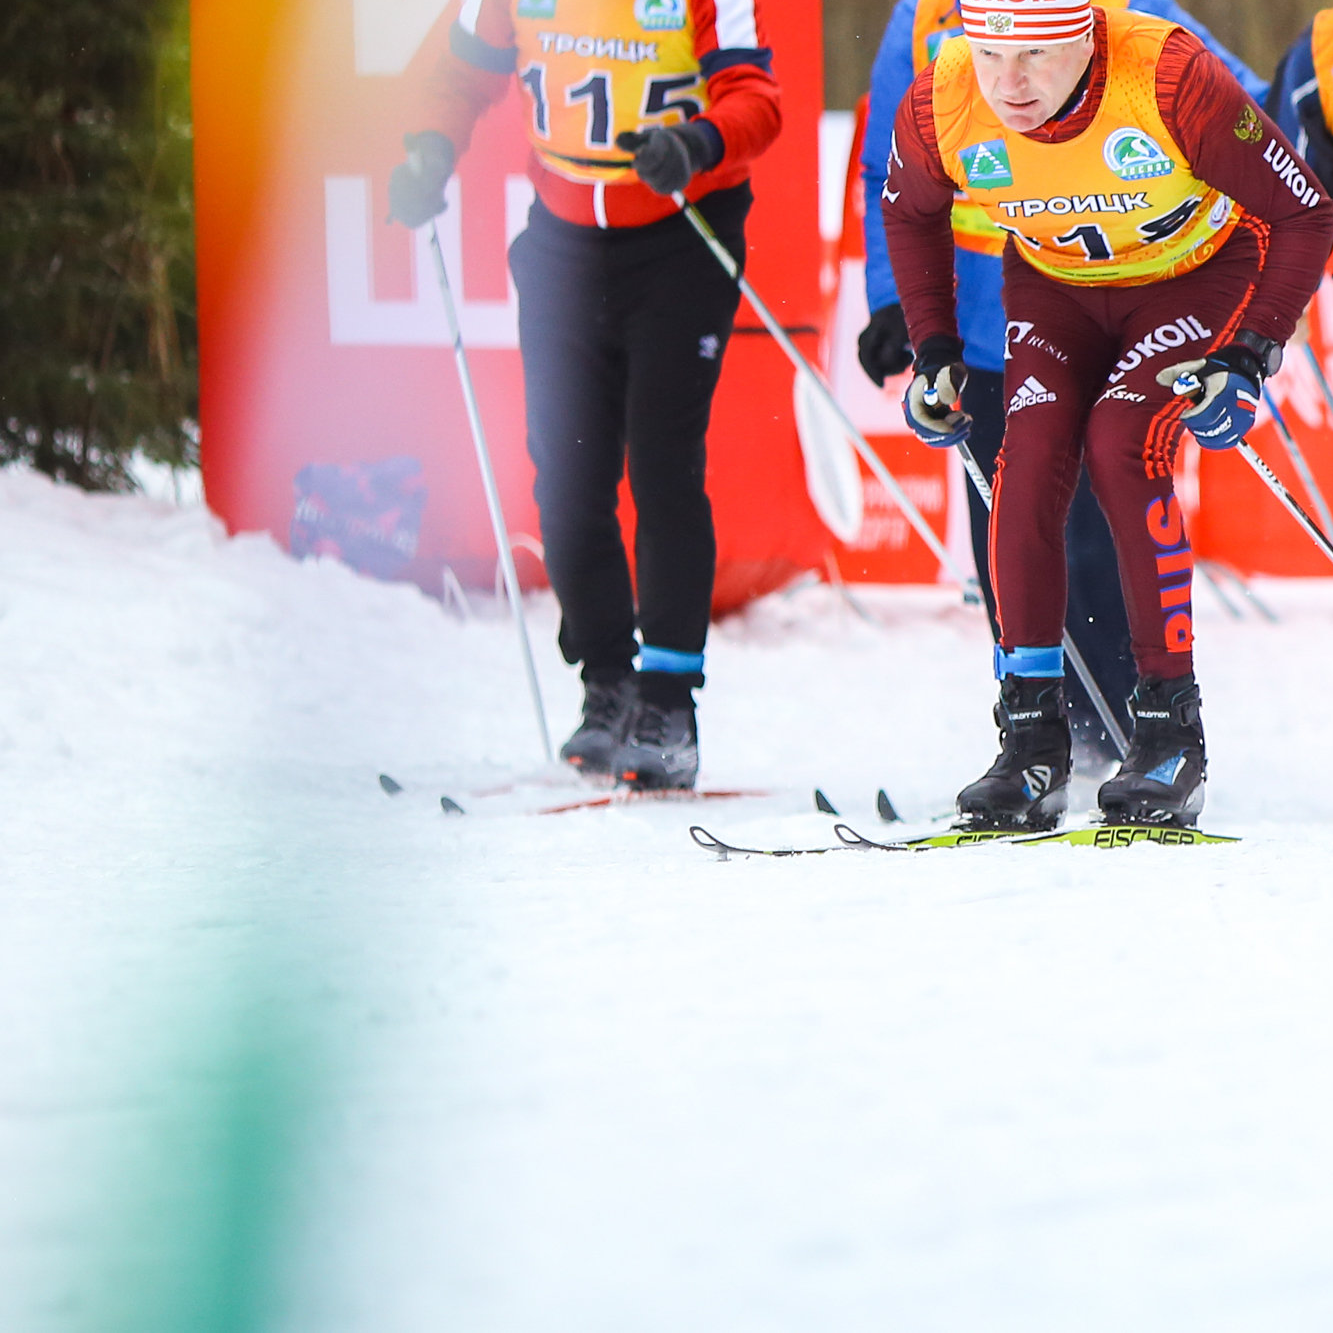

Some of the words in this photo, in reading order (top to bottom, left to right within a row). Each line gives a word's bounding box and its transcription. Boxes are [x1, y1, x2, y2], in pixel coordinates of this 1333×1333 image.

[537, 30, 660, 64] ТРОИЦК
[519, 59, 706, 152] 115
[998, 192, 1154, 218] ТРОИЦК
[1029, 334, 1069, 365] RUSAL
[1094, 829, 1195, 848] FISCHER
